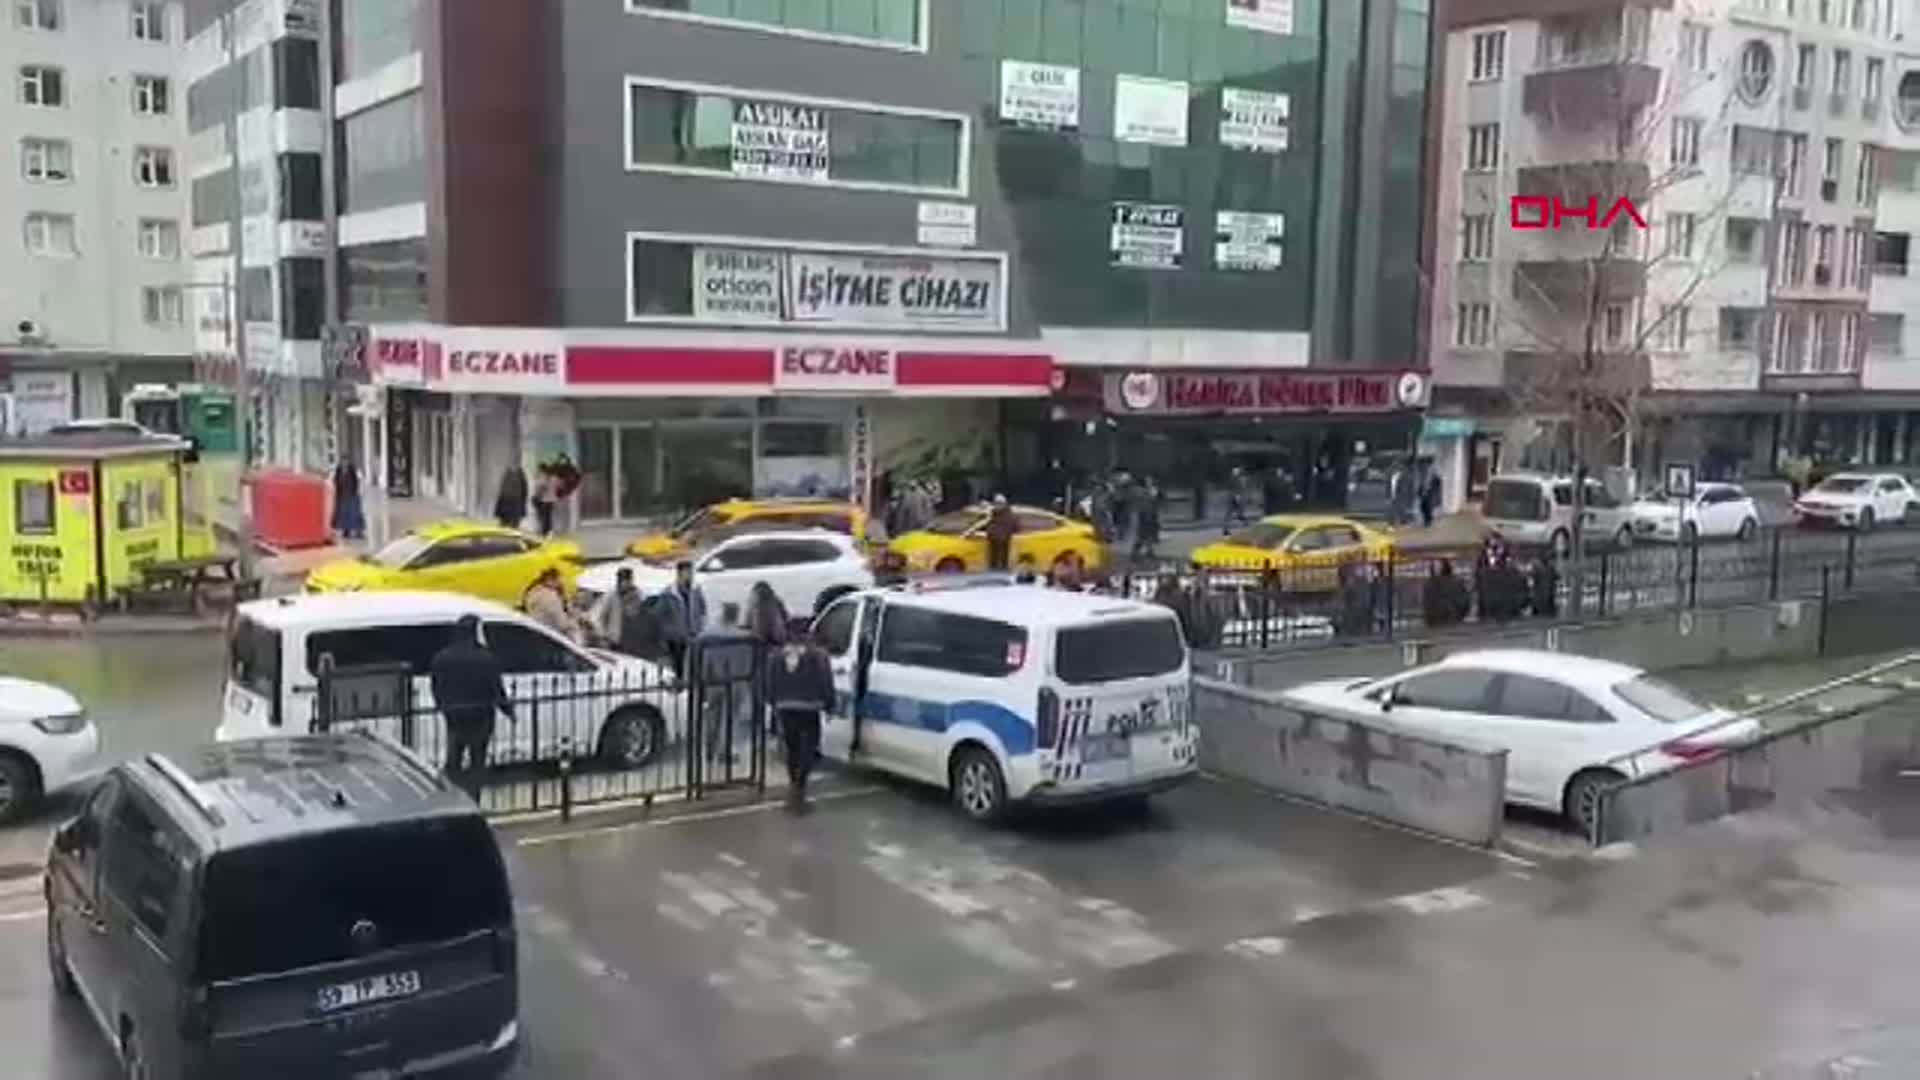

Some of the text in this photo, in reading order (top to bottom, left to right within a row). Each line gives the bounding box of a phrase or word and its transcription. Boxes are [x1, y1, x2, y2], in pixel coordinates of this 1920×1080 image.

[737, 102, 824, 130] AVUKAT
[800, 266, 990, 312] İŞİTME CİHAZI
[449, 350, 558, 375] ECZANE
[782, 348, 889, 375] ECZANE
